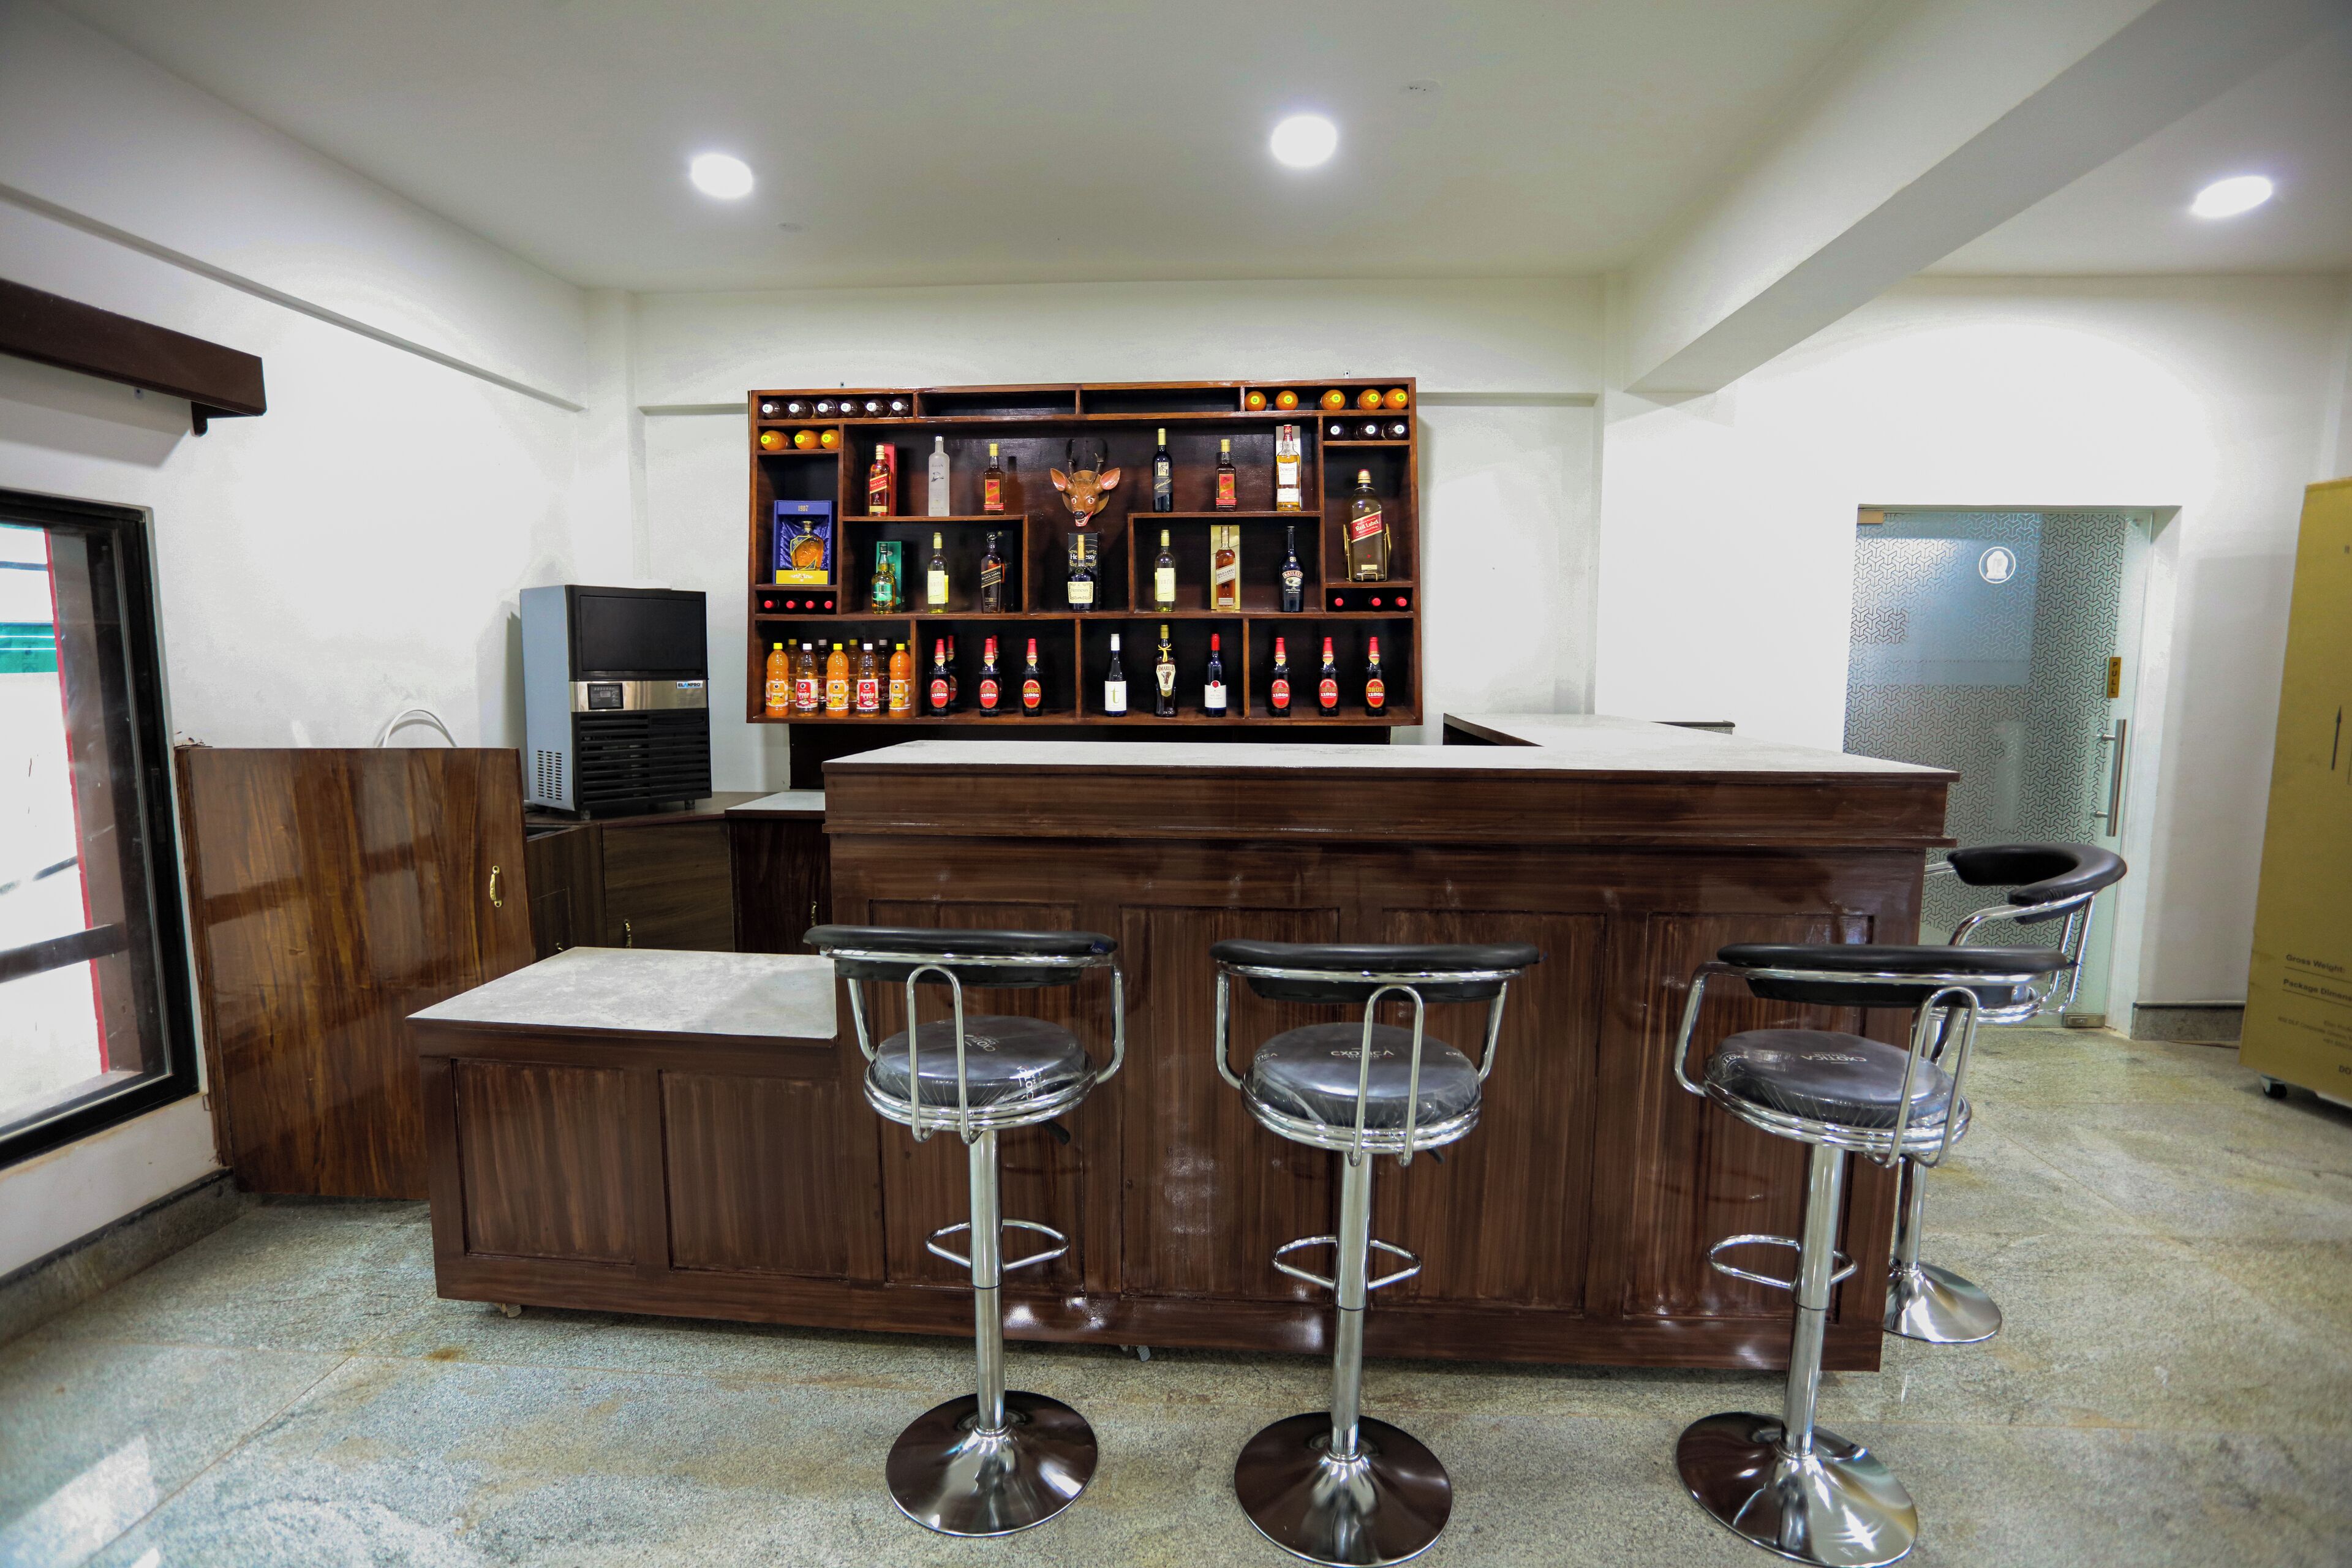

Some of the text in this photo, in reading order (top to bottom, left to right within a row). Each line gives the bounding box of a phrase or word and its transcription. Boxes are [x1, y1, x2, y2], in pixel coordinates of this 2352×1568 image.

[1366, 519, 1379, 528] Label
[1110, 685, 1120, 704] t
[2286, 954, 2311, 965] Gross
[2283, 979, 2318, 993] Package
